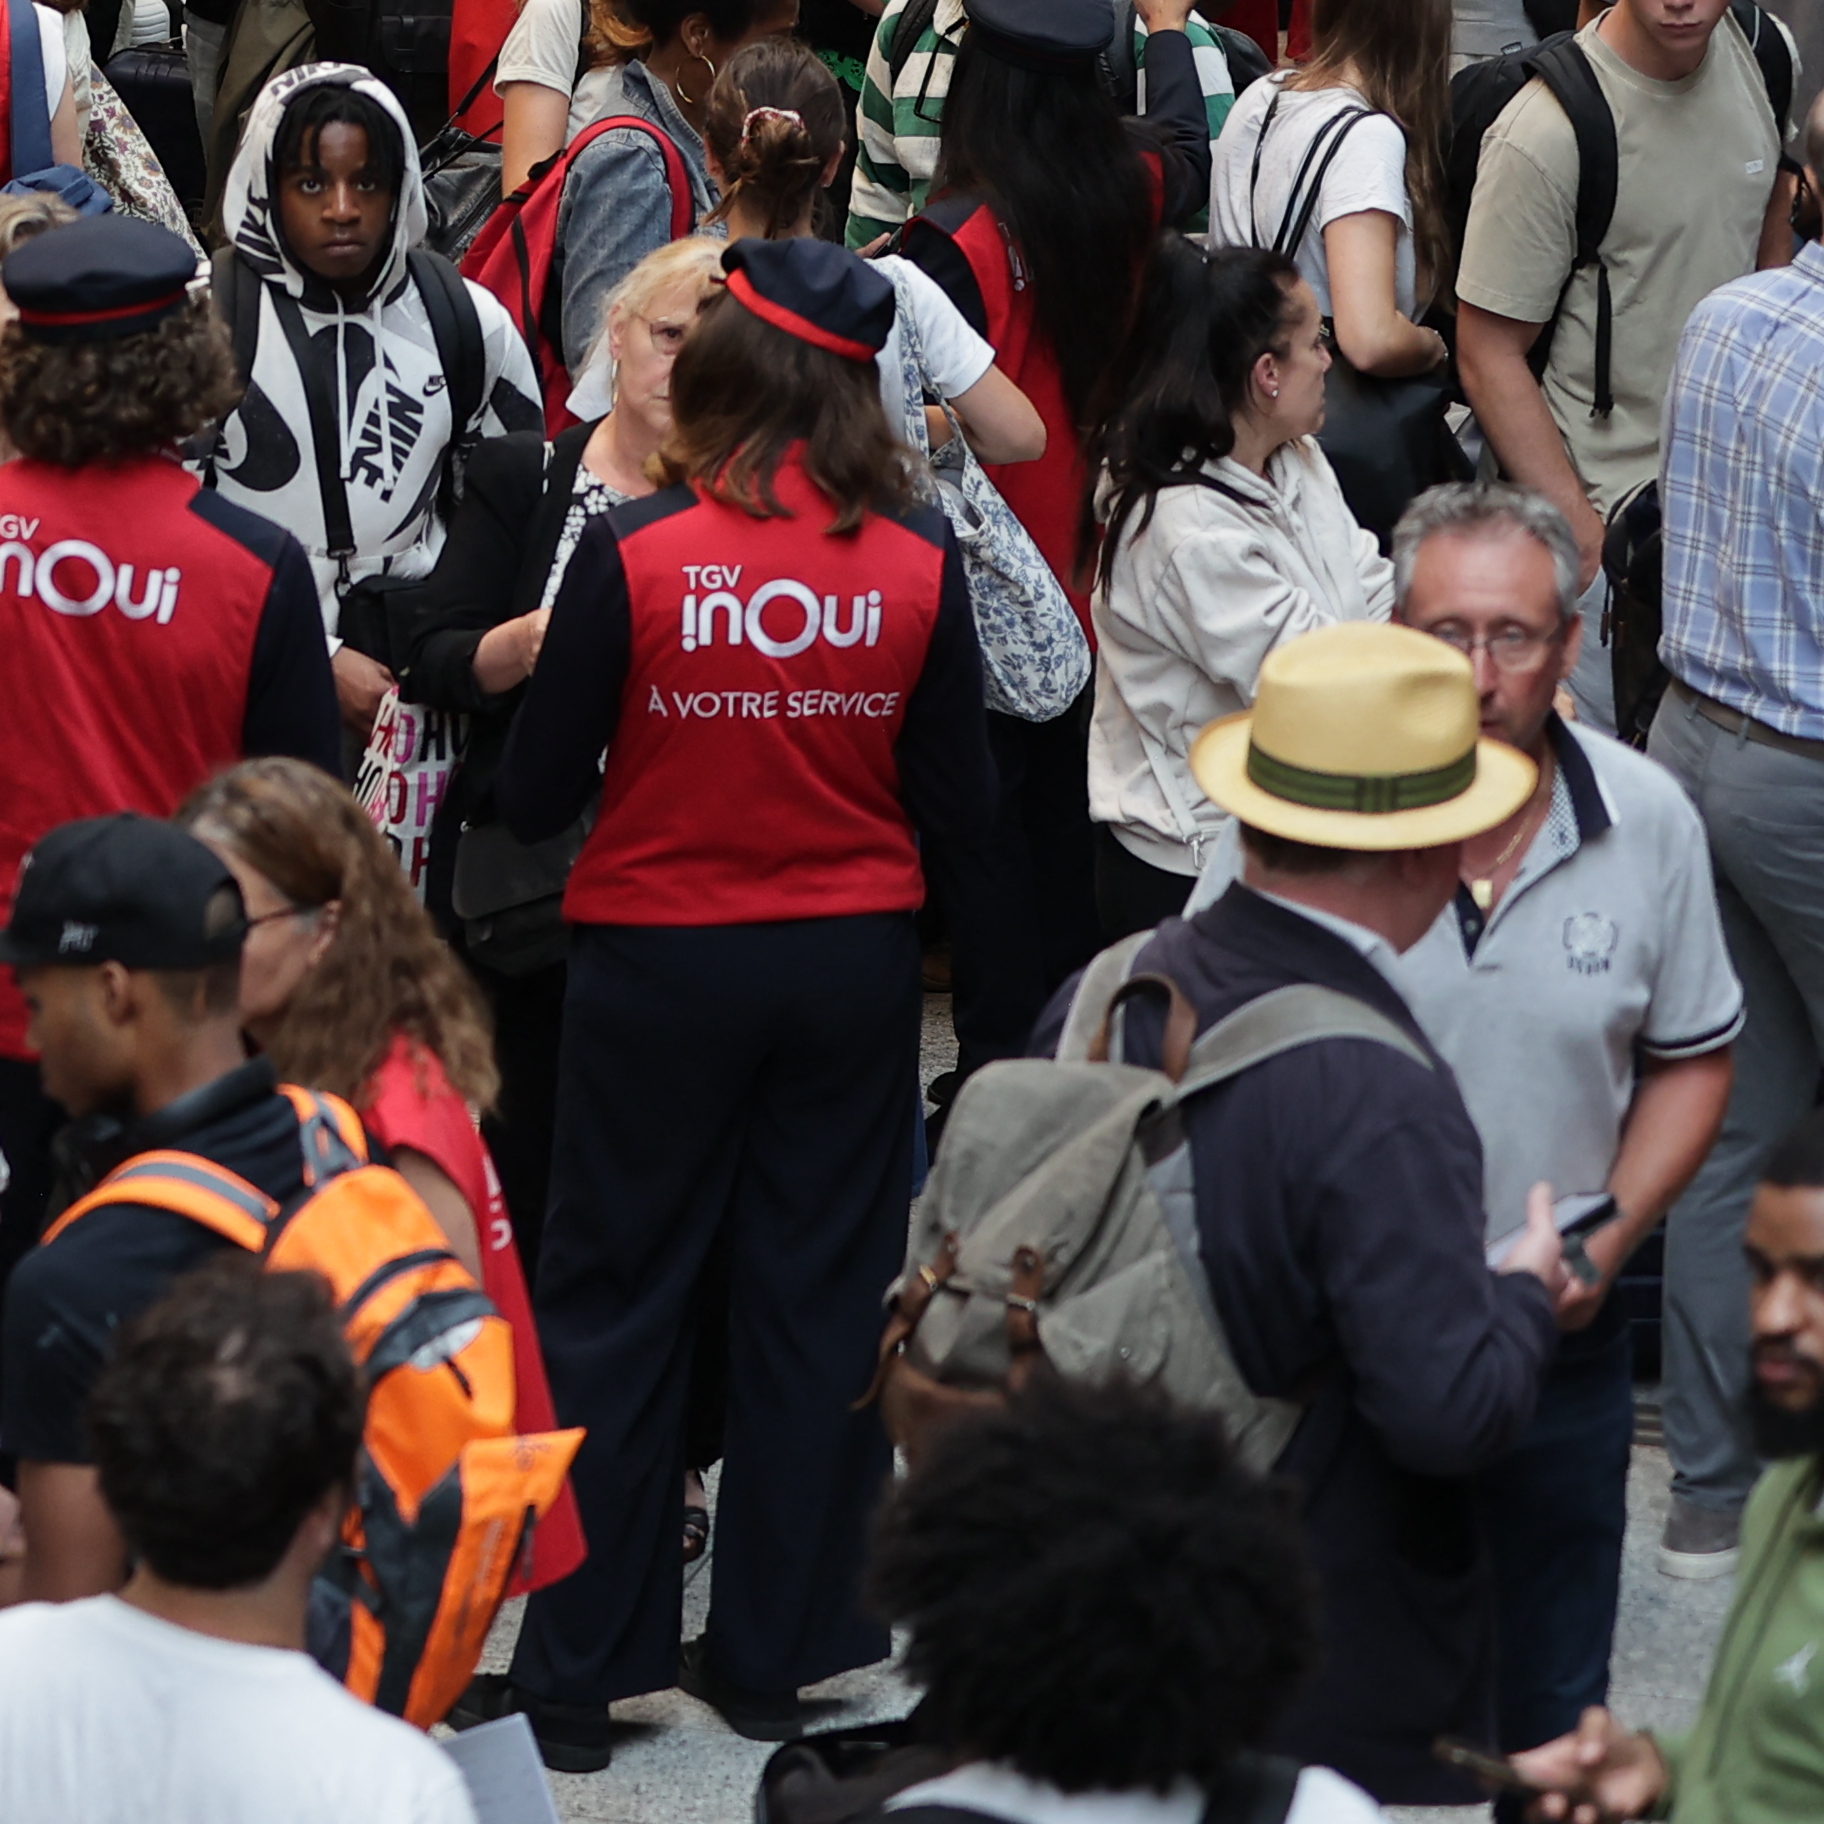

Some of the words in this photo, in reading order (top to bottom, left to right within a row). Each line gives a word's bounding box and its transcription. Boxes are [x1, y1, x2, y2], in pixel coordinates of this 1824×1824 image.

[350, 380, 426, 504] NIKE
[682, 563, 744, 591] TGV
[648, 685, 669, 718] À
[672, 689, 780, 719] VOTRE
[785, 689, 902, 719] SERVICE
